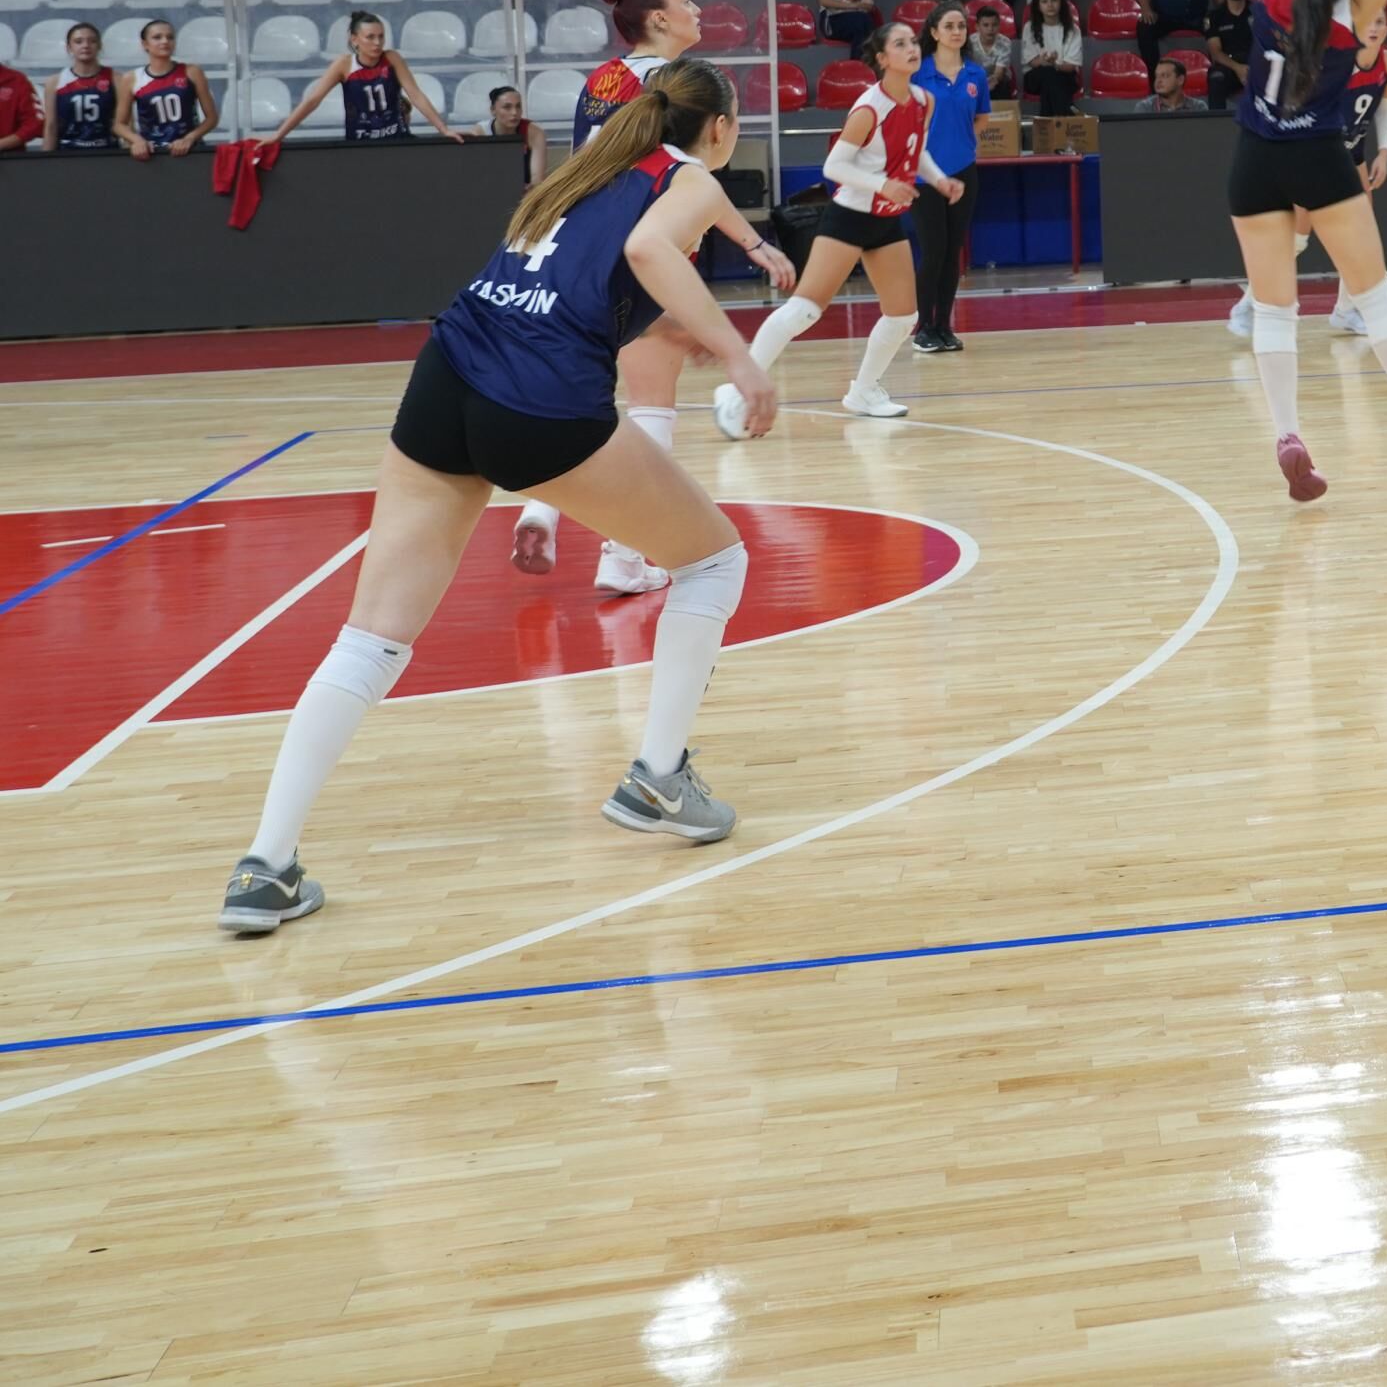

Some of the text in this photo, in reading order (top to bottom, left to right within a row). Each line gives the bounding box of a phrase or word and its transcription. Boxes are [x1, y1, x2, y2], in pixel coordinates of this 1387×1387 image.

[70, 94, 101, 122] 15
[151, 93, 183, 124] 10
[363, 83, 388, 112] 11
[1354, 94, 1374, 125] 9
[505, 216, 567, 273] 4
